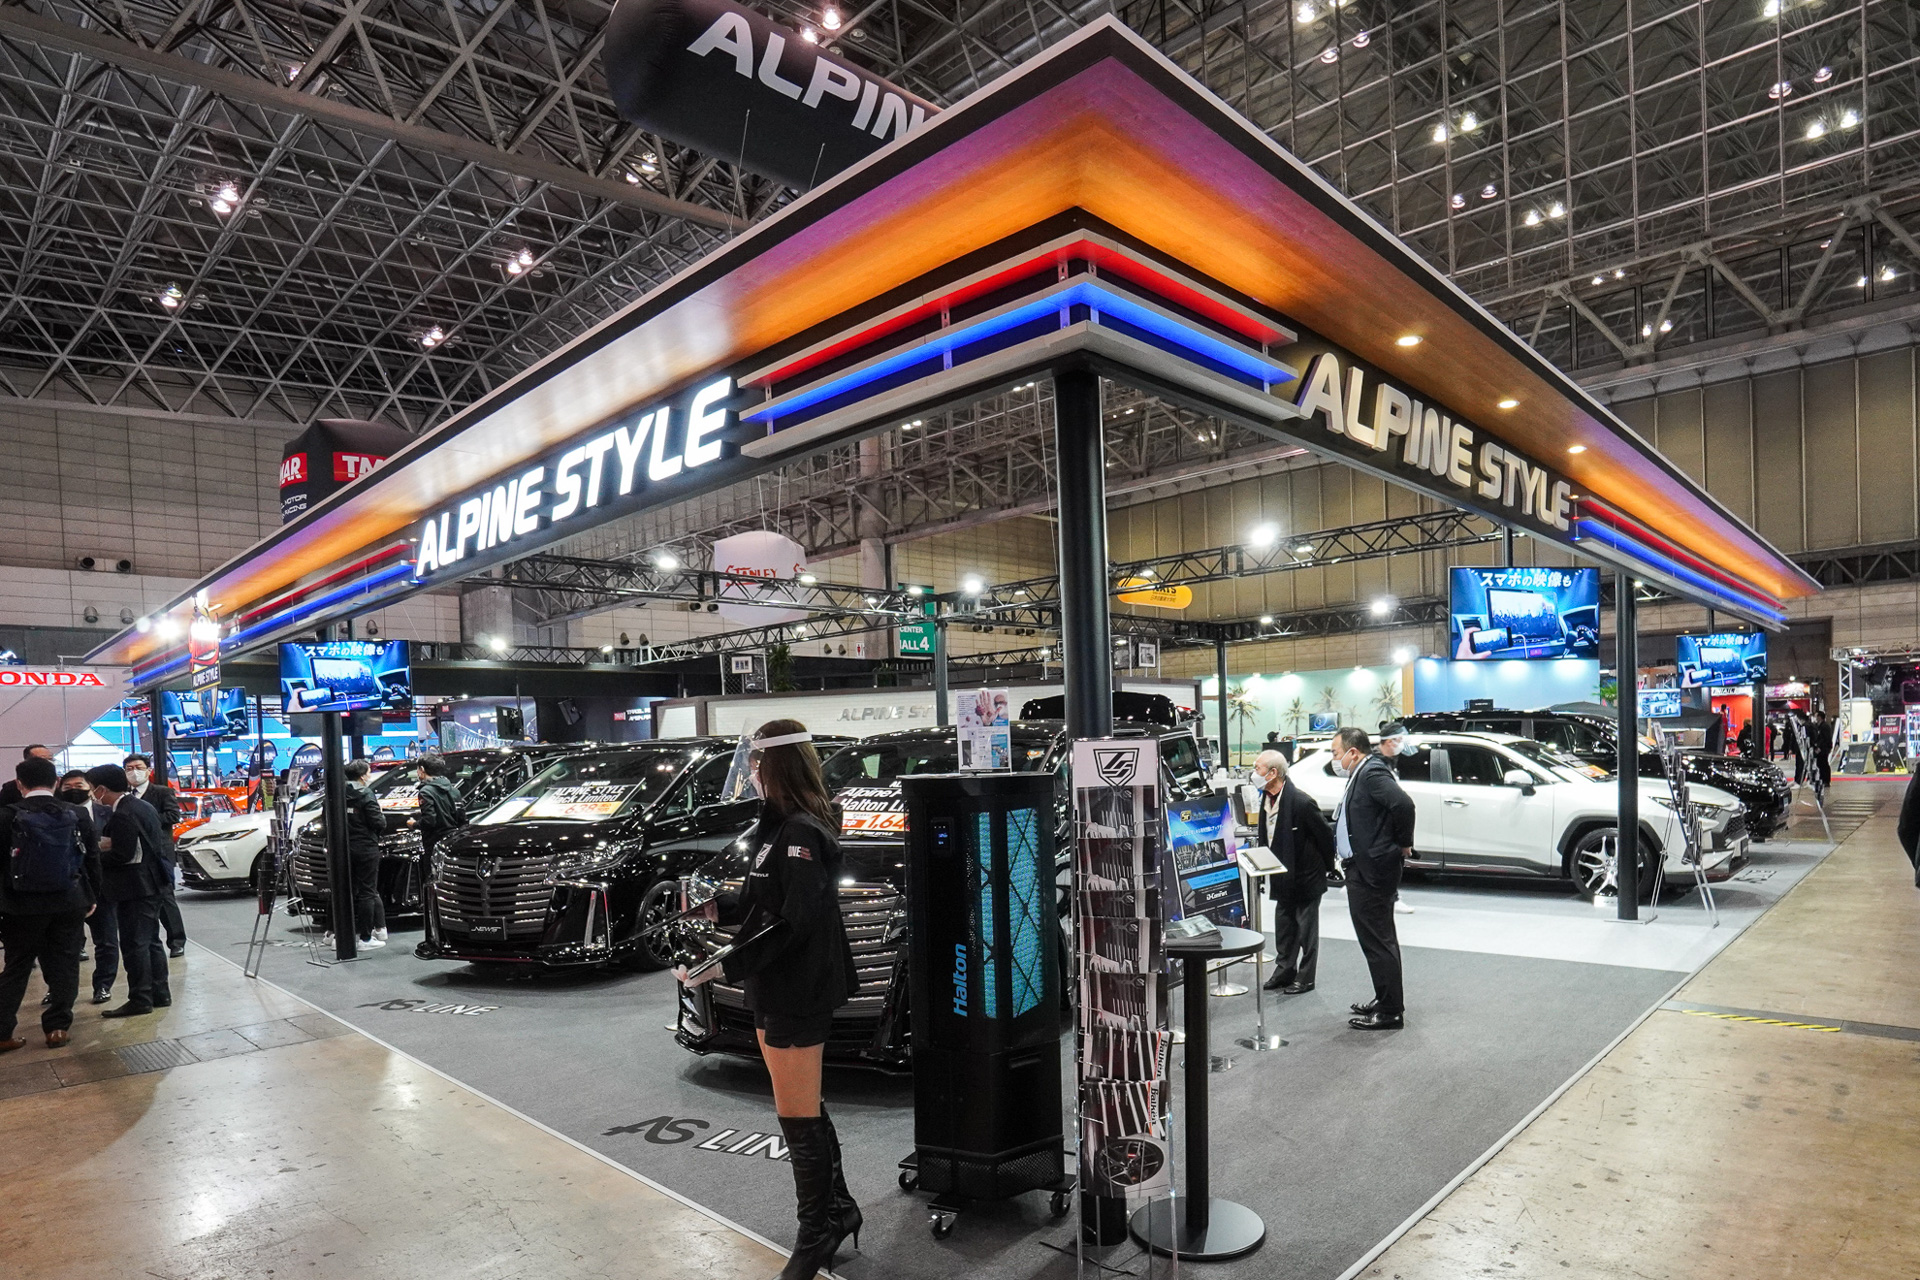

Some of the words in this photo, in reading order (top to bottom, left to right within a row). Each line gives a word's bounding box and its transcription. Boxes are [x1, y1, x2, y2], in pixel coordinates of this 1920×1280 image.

[686, 12, 938, 140] ALPIN
[1297, 352, 1474, 488] ALPINE
[1478, 441, 1571, 531] STYLE
[342, 455, 385, 478] TM
[416, 466, 544, 577] ALPINE
[551, 376, 731, 522] STYLE
[1480, 572, 1572, 587] スマホの映像も
[919, 636, 929, 651] 4
[1695, 635, 1750, 647] スマホの映像も
[304, 643, 385, 657] スマホの映像も
[0, 671, 105, 686] ONDA
[837, 705, 905, 721] ALPINE
[553, 787, 592, 796] ALPINE
[593, 785, 626, 795] STYLE
[577, 793, 620, 803] Limited
[839, 788, 892, 798] Alpine
[840, 799, 889, 812] Halton
[868, 814, 904, 829] 1,64
[953, 943, 967, 1017] Halton
[410, 1003, 502, 1016] LINE
[693, 1128, 792, 1161] LIN
